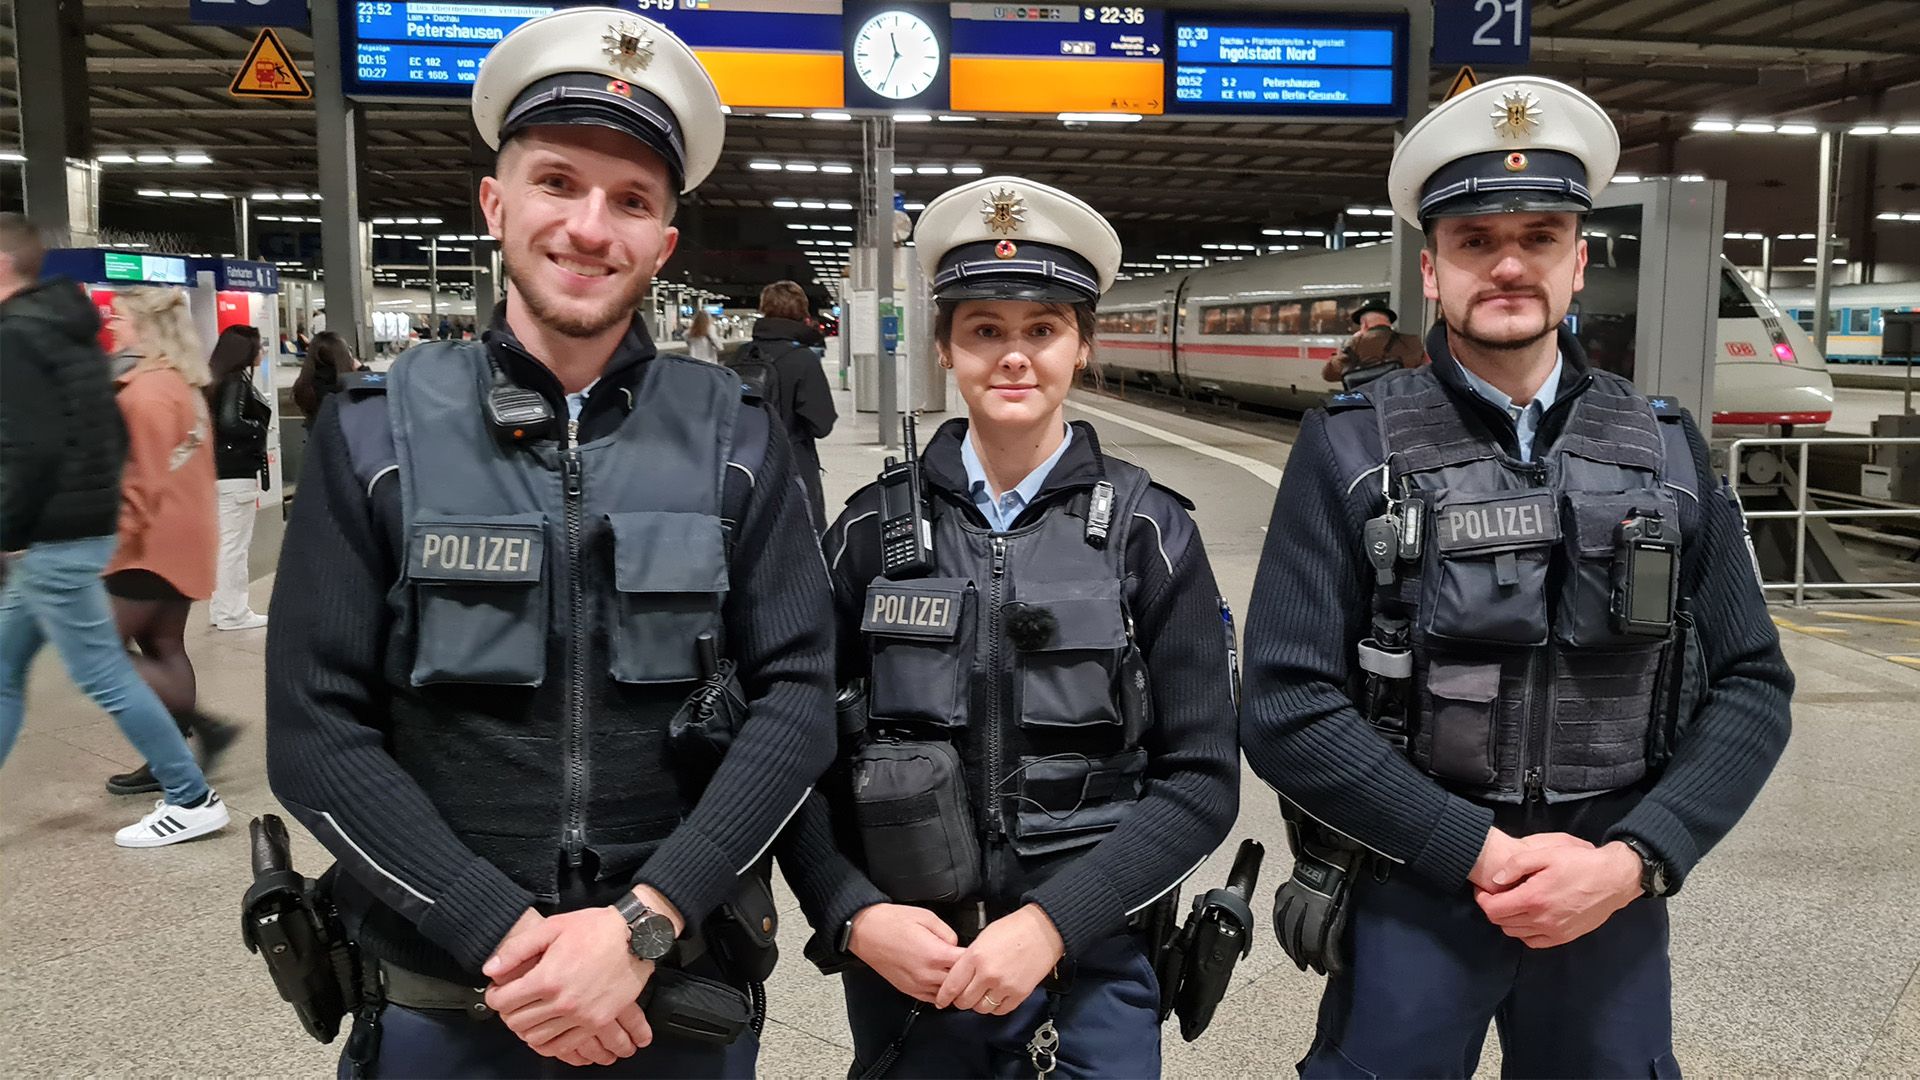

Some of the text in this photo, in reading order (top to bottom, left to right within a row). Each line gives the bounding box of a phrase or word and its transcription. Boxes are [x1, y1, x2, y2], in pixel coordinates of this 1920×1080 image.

[358, 3, 392, 16] 23:52
[1099, 6, 1145, 25] 22-36
[1472, 0, 1523, 46] 21
[406, 23, 503, 40] Petershausen
[1177, 27, 1209, 40] 00:30
[358, 54, 387, 65] 00:15
[409, 57, 422, 66] EC
[1219, 46, 1316, 63] Ingolstadt Nord
[358, 67, 387, 78] 00:27
[410, 70, 424, 80] ICE
[1176, 76, 1203, 87] 00:52
[1263, 77, 1321, 88] Petershausen
[1263, 91, 1279, 100] von
[1728, 343, 1755, 356] DB
[1449, 503, 1545, 542] POLIZEI
[421, 533, 532, 573] POLIZEI
[871, 594, 951, 627] POLIZEI
